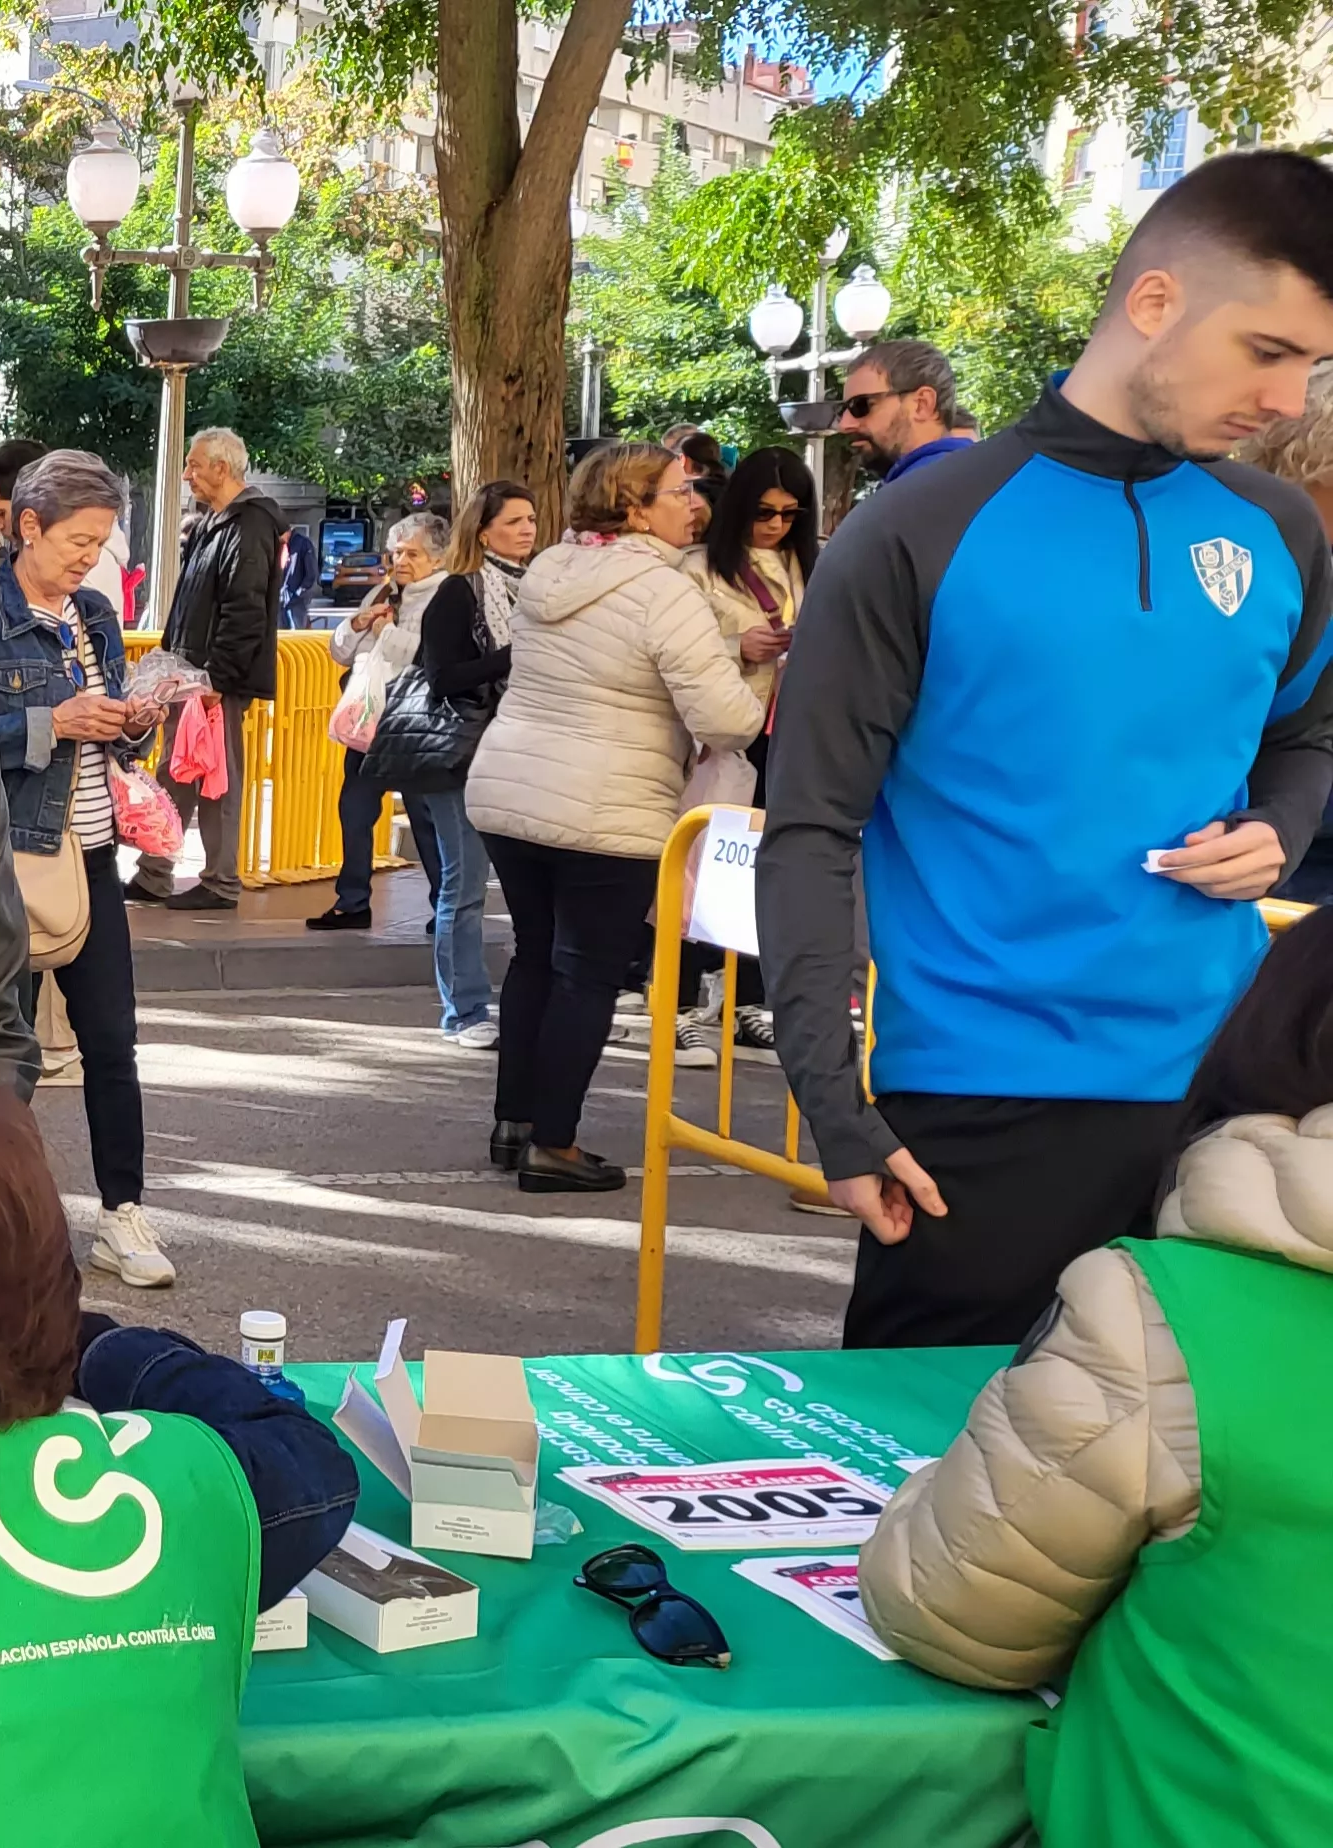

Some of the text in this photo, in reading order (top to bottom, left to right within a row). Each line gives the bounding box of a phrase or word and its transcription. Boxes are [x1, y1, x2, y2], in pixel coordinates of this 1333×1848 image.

[720, 1403, 815, 1450] contra
[615, 1473, 833, 1492] CONTRA EL CÁNCER
[636, 1486, 883, 1523] 2005
[48, 1633, 128, 1657] ESPAÑOLA
[128, 1628, 178, 1646] CONTRA
[176, 1626, 193, 1641] EL
